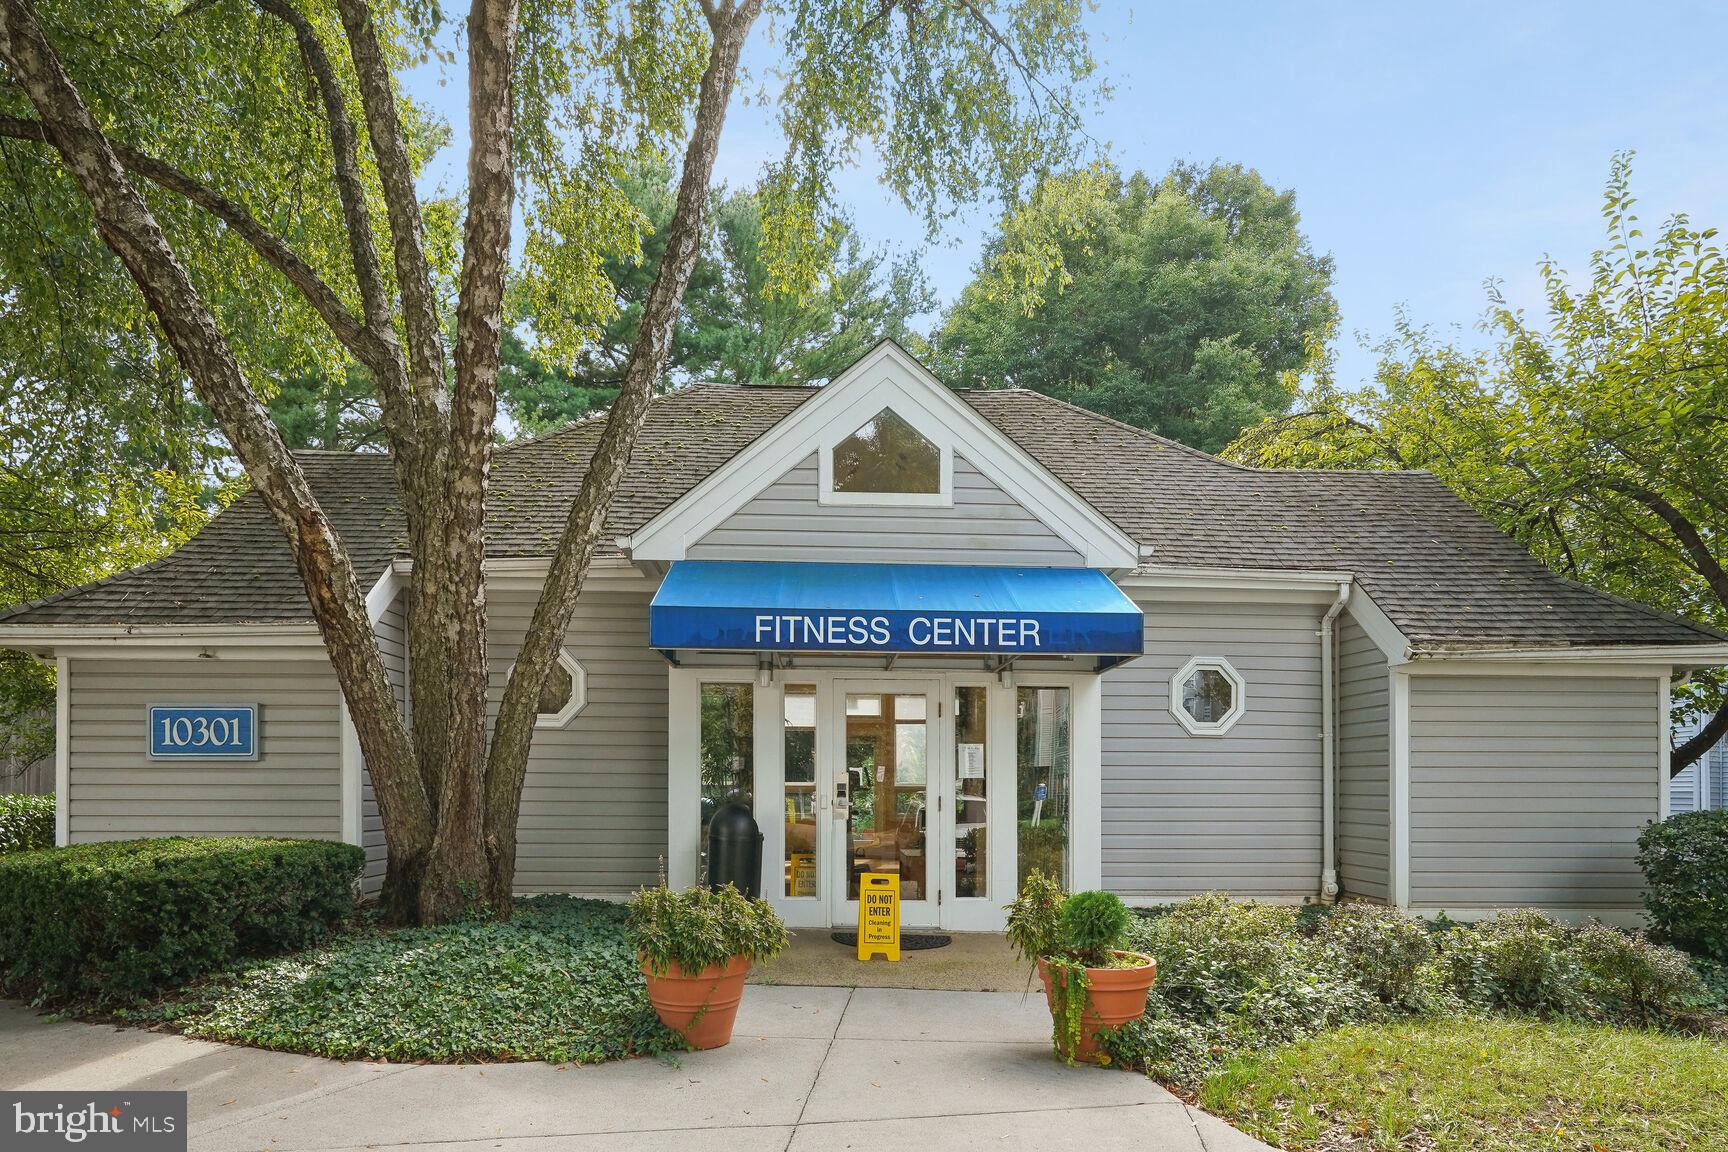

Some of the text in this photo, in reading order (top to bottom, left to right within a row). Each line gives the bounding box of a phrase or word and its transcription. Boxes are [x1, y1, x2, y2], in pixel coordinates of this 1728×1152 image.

[754, 615, 891, 645] FITNESS
[908, 616, 1041, 647] CENTER
[160, 716, 243, 747] 10301
[867, 894, 893, 905] DO NOT
[868, 906, 891, 917] ENTER
[868, 919, 891, 927] Cleaning
[868, 933, 891, 941] Progress
